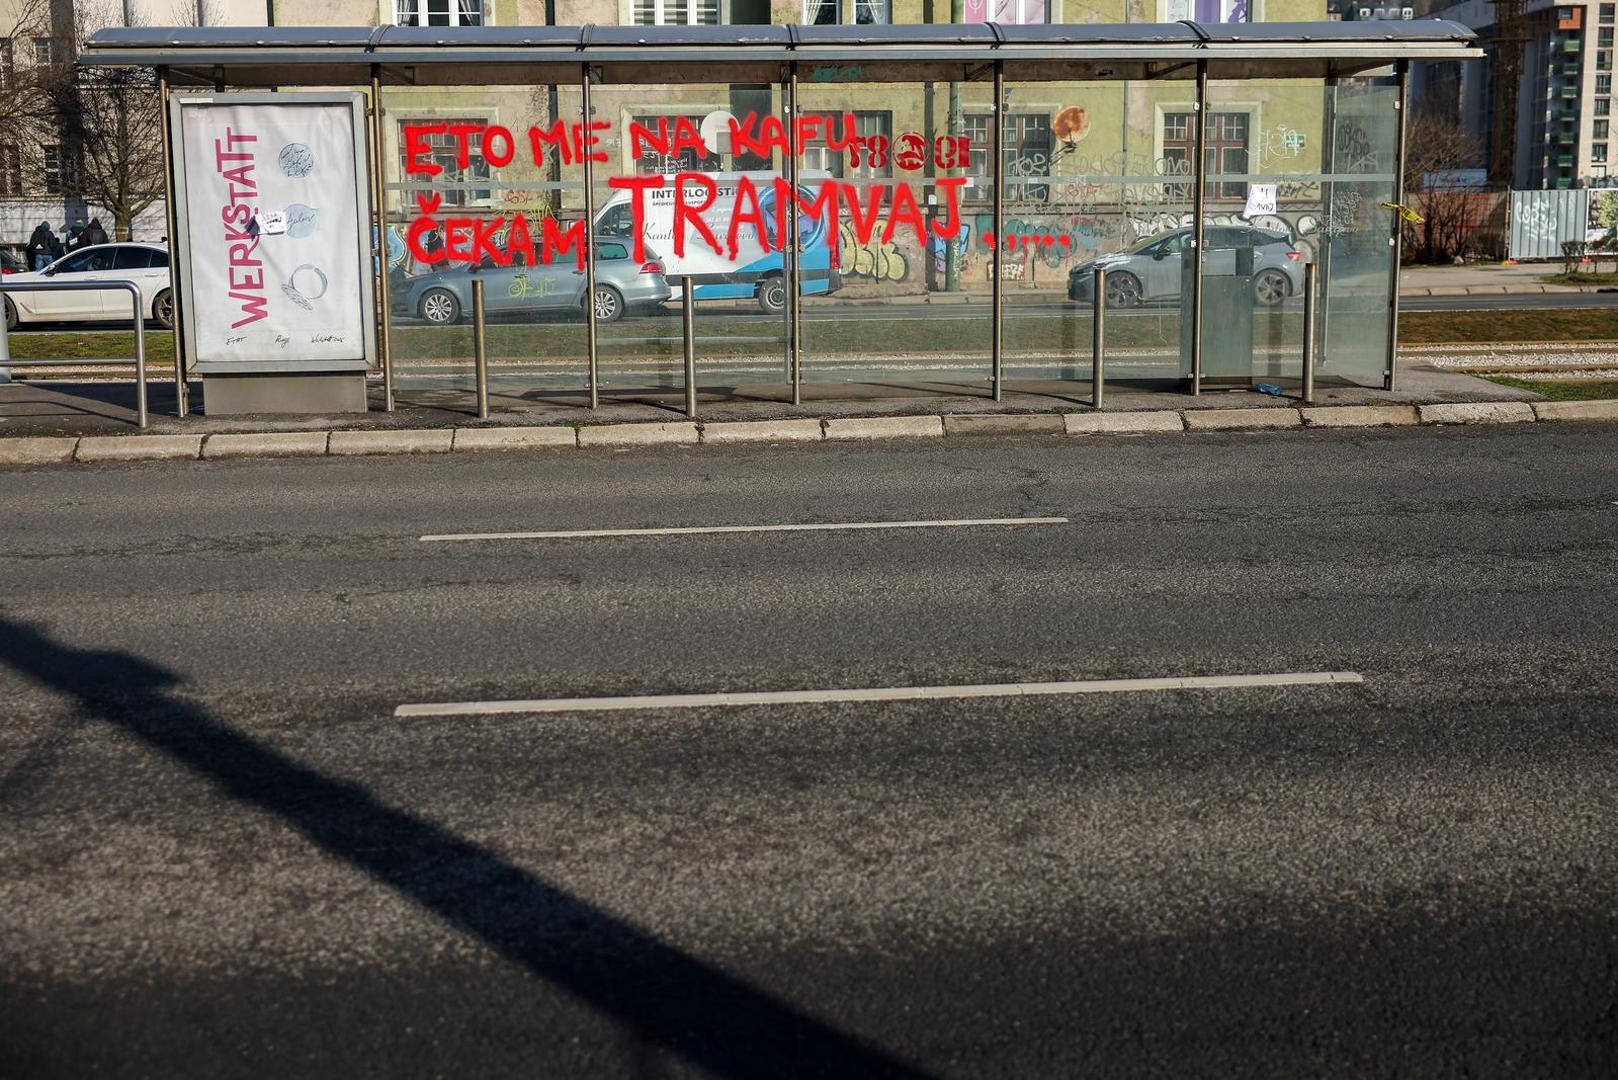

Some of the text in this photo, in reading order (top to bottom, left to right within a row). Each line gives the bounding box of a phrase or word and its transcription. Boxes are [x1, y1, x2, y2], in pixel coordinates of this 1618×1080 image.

[403, 120, 516, 177] ETO
[527, 119, 612, 168] ME
[629, 115, 708, 160] NA
[728, 111, 862, 160] KAFU
[215, 127, 269, 329] WERKSTATT
[406, 192, 588, 273] ČEKAM
[607, 172, 968, 265] TRAMVAJ
